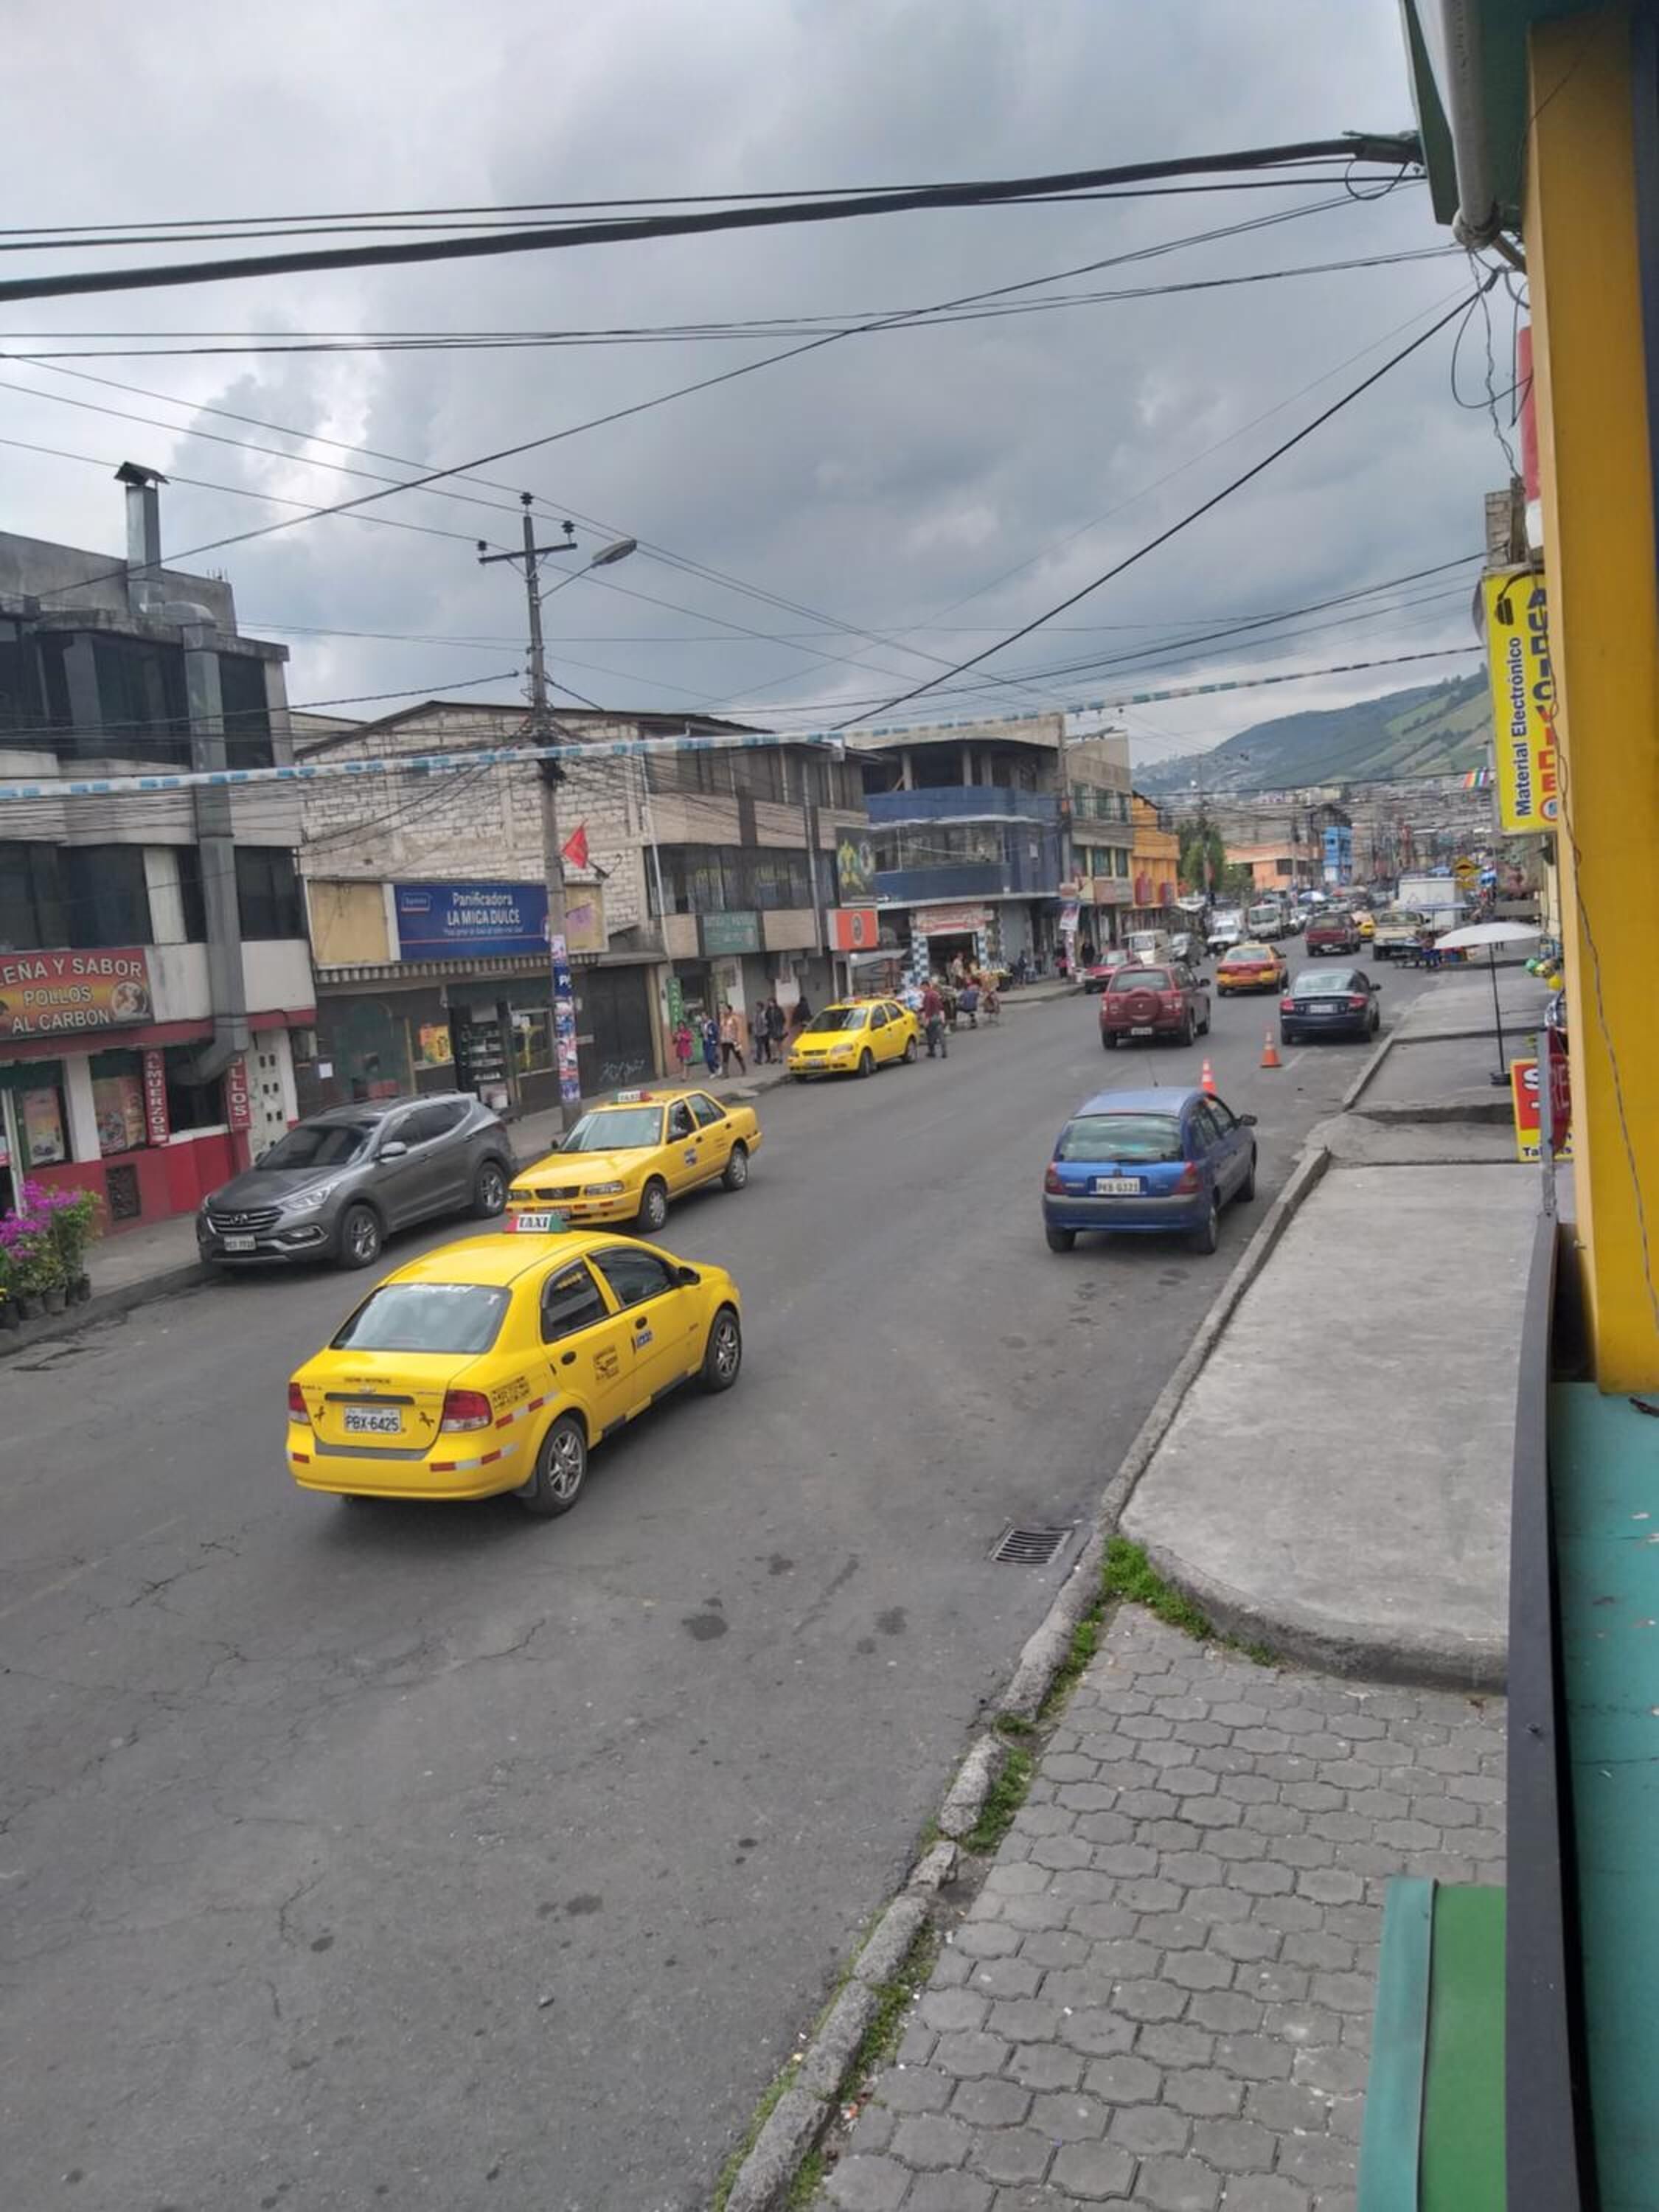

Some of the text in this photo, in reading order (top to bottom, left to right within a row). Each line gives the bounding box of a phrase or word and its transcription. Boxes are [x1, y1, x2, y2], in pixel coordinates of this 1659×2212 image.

[1509, 637, 1531, 817] Material Electrónico
[452, 890, 513, 907] Panificadora
[446, 908, 521, 926] LA MIGA DULCE
[52, 957, 65, 975] Y
[72, 958, 142, 978] SABOR
[23, 984, 91, 1006] POLLOS
[12, 1008, 110, 1034] AL CARBON
[145, 1050, 166, 1134] ALMUERZOS
[519, 1217, 549, 1229] TAXI
[344, 1414, 399, 1432] PBX-6425
